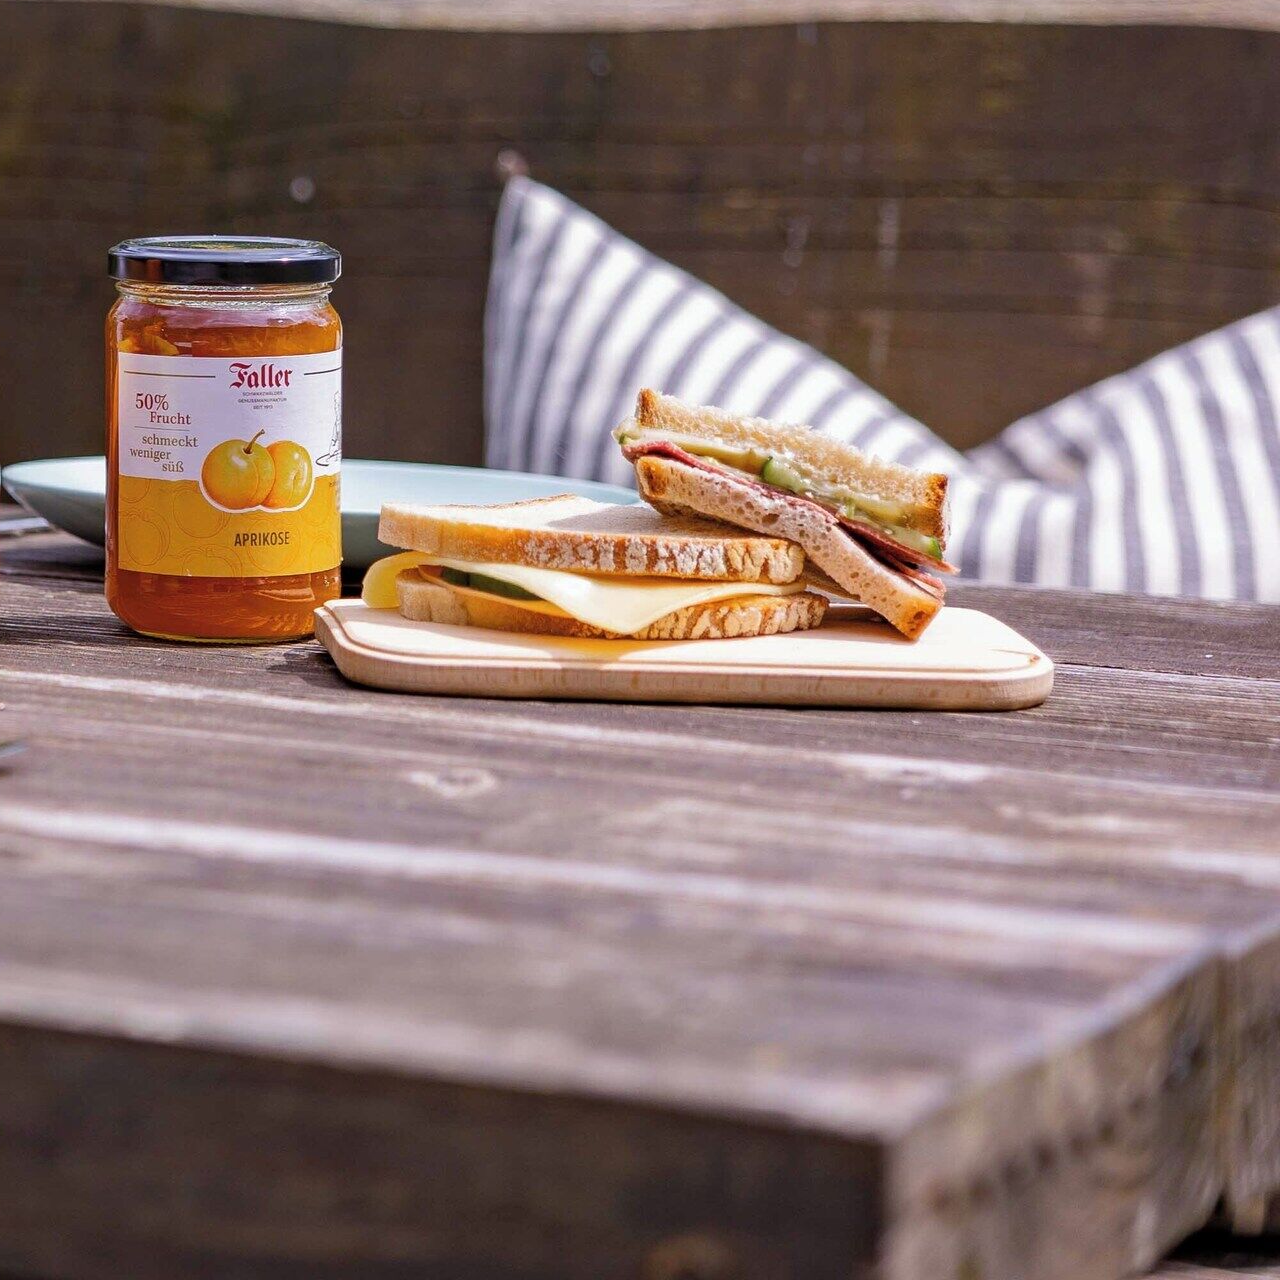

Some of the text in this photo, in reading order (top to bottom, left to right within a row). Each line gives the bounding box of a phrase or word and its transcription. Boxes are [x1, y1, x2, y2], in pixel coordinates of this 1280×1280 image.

[229, 363, 293, 388] Faller
[135, 393, 169, 411] 50%
[149, 411, 191, 425] Frucht
[141, 434, 199, 448] schmeckt
[129, 447, 171, 463] weniger
[162, 460, 184, 473] süß
[234, 531, 290, 547] APRIKOSE
